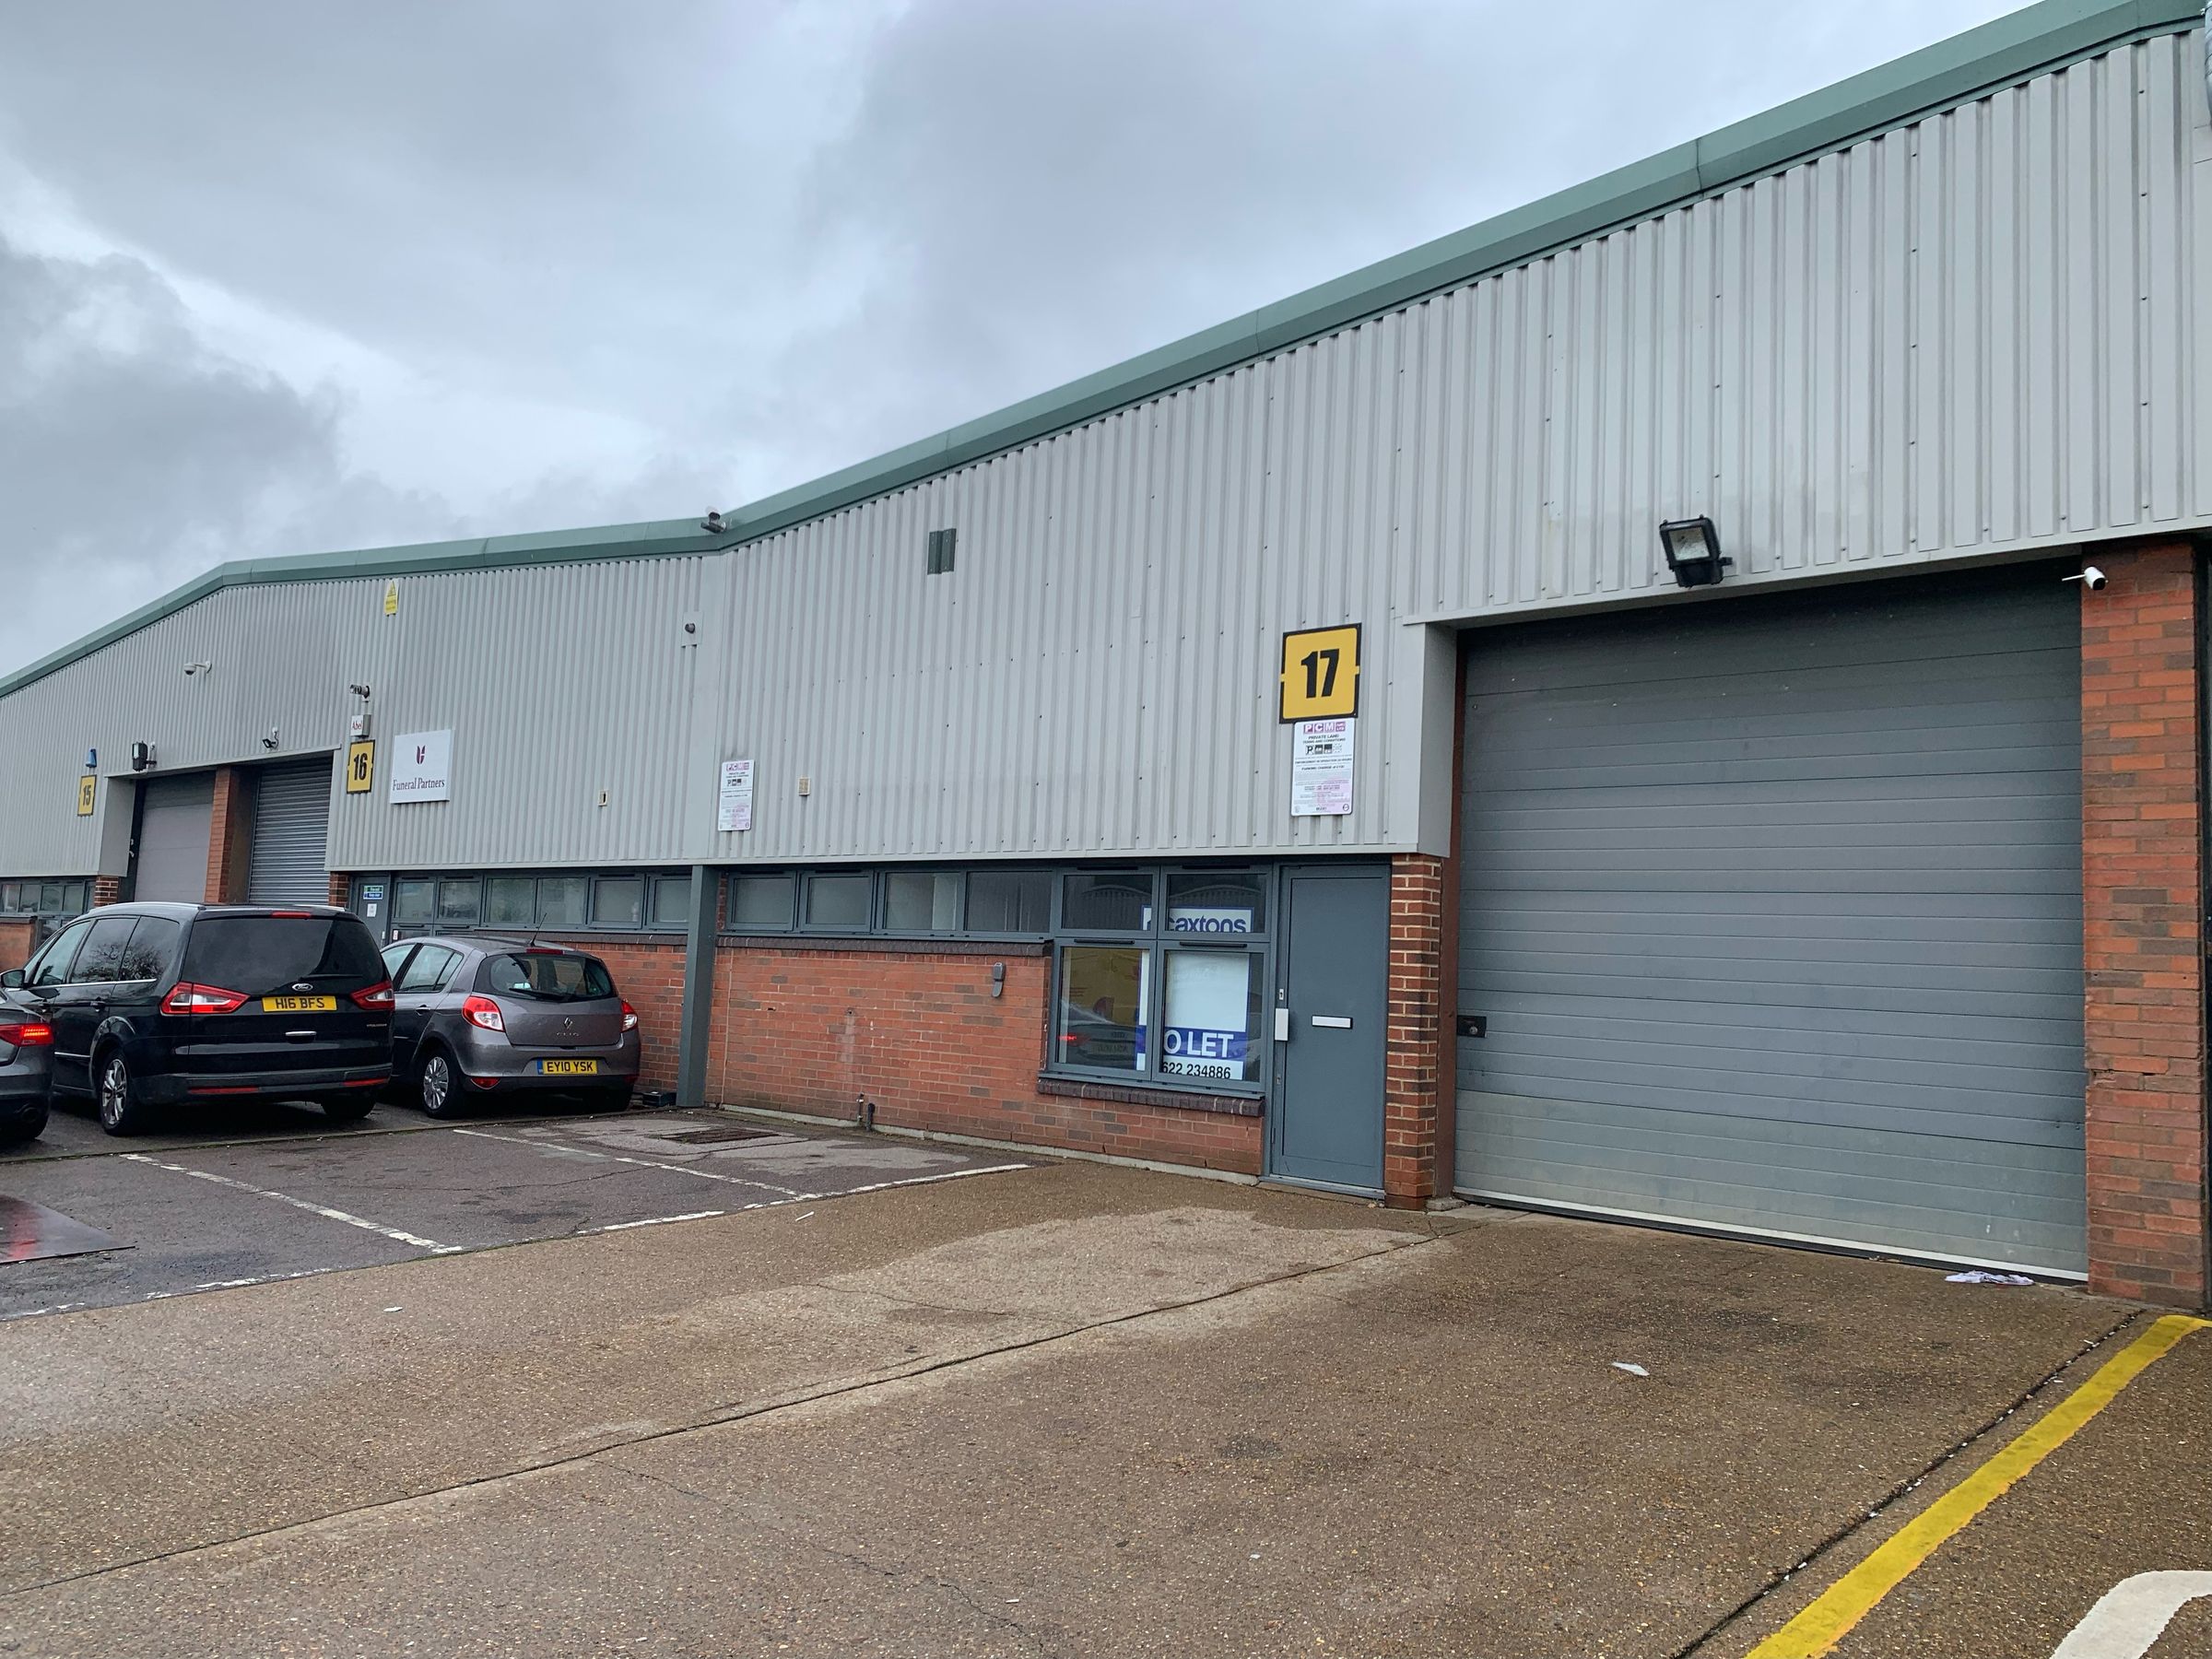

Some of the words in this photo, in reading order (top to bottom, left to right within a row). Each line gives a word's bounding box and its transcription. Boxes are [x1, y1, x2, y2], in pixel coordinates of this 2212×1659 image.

[1300, 649, 1340, 699] 17
[1303, 722, 1335, 734] PCM
[354, 753, 368, 781] 16
[393, 778, 417, 791] Funeral
[418, 777, 445, 789] Partners
[83, 784, 91, 806] 15
[300, 997, 325, 1008] BFS
[1164, 1030, 1182, 1054] O
[1187, 1030, 1234, 1058] LET
[547, 1061, 571, 1072] EY10
[574, 1061, 594, 1071] YSK
[1162, 1061, 1182, 1076] 622
[1187, 1063, 1231, 1080] 234886
